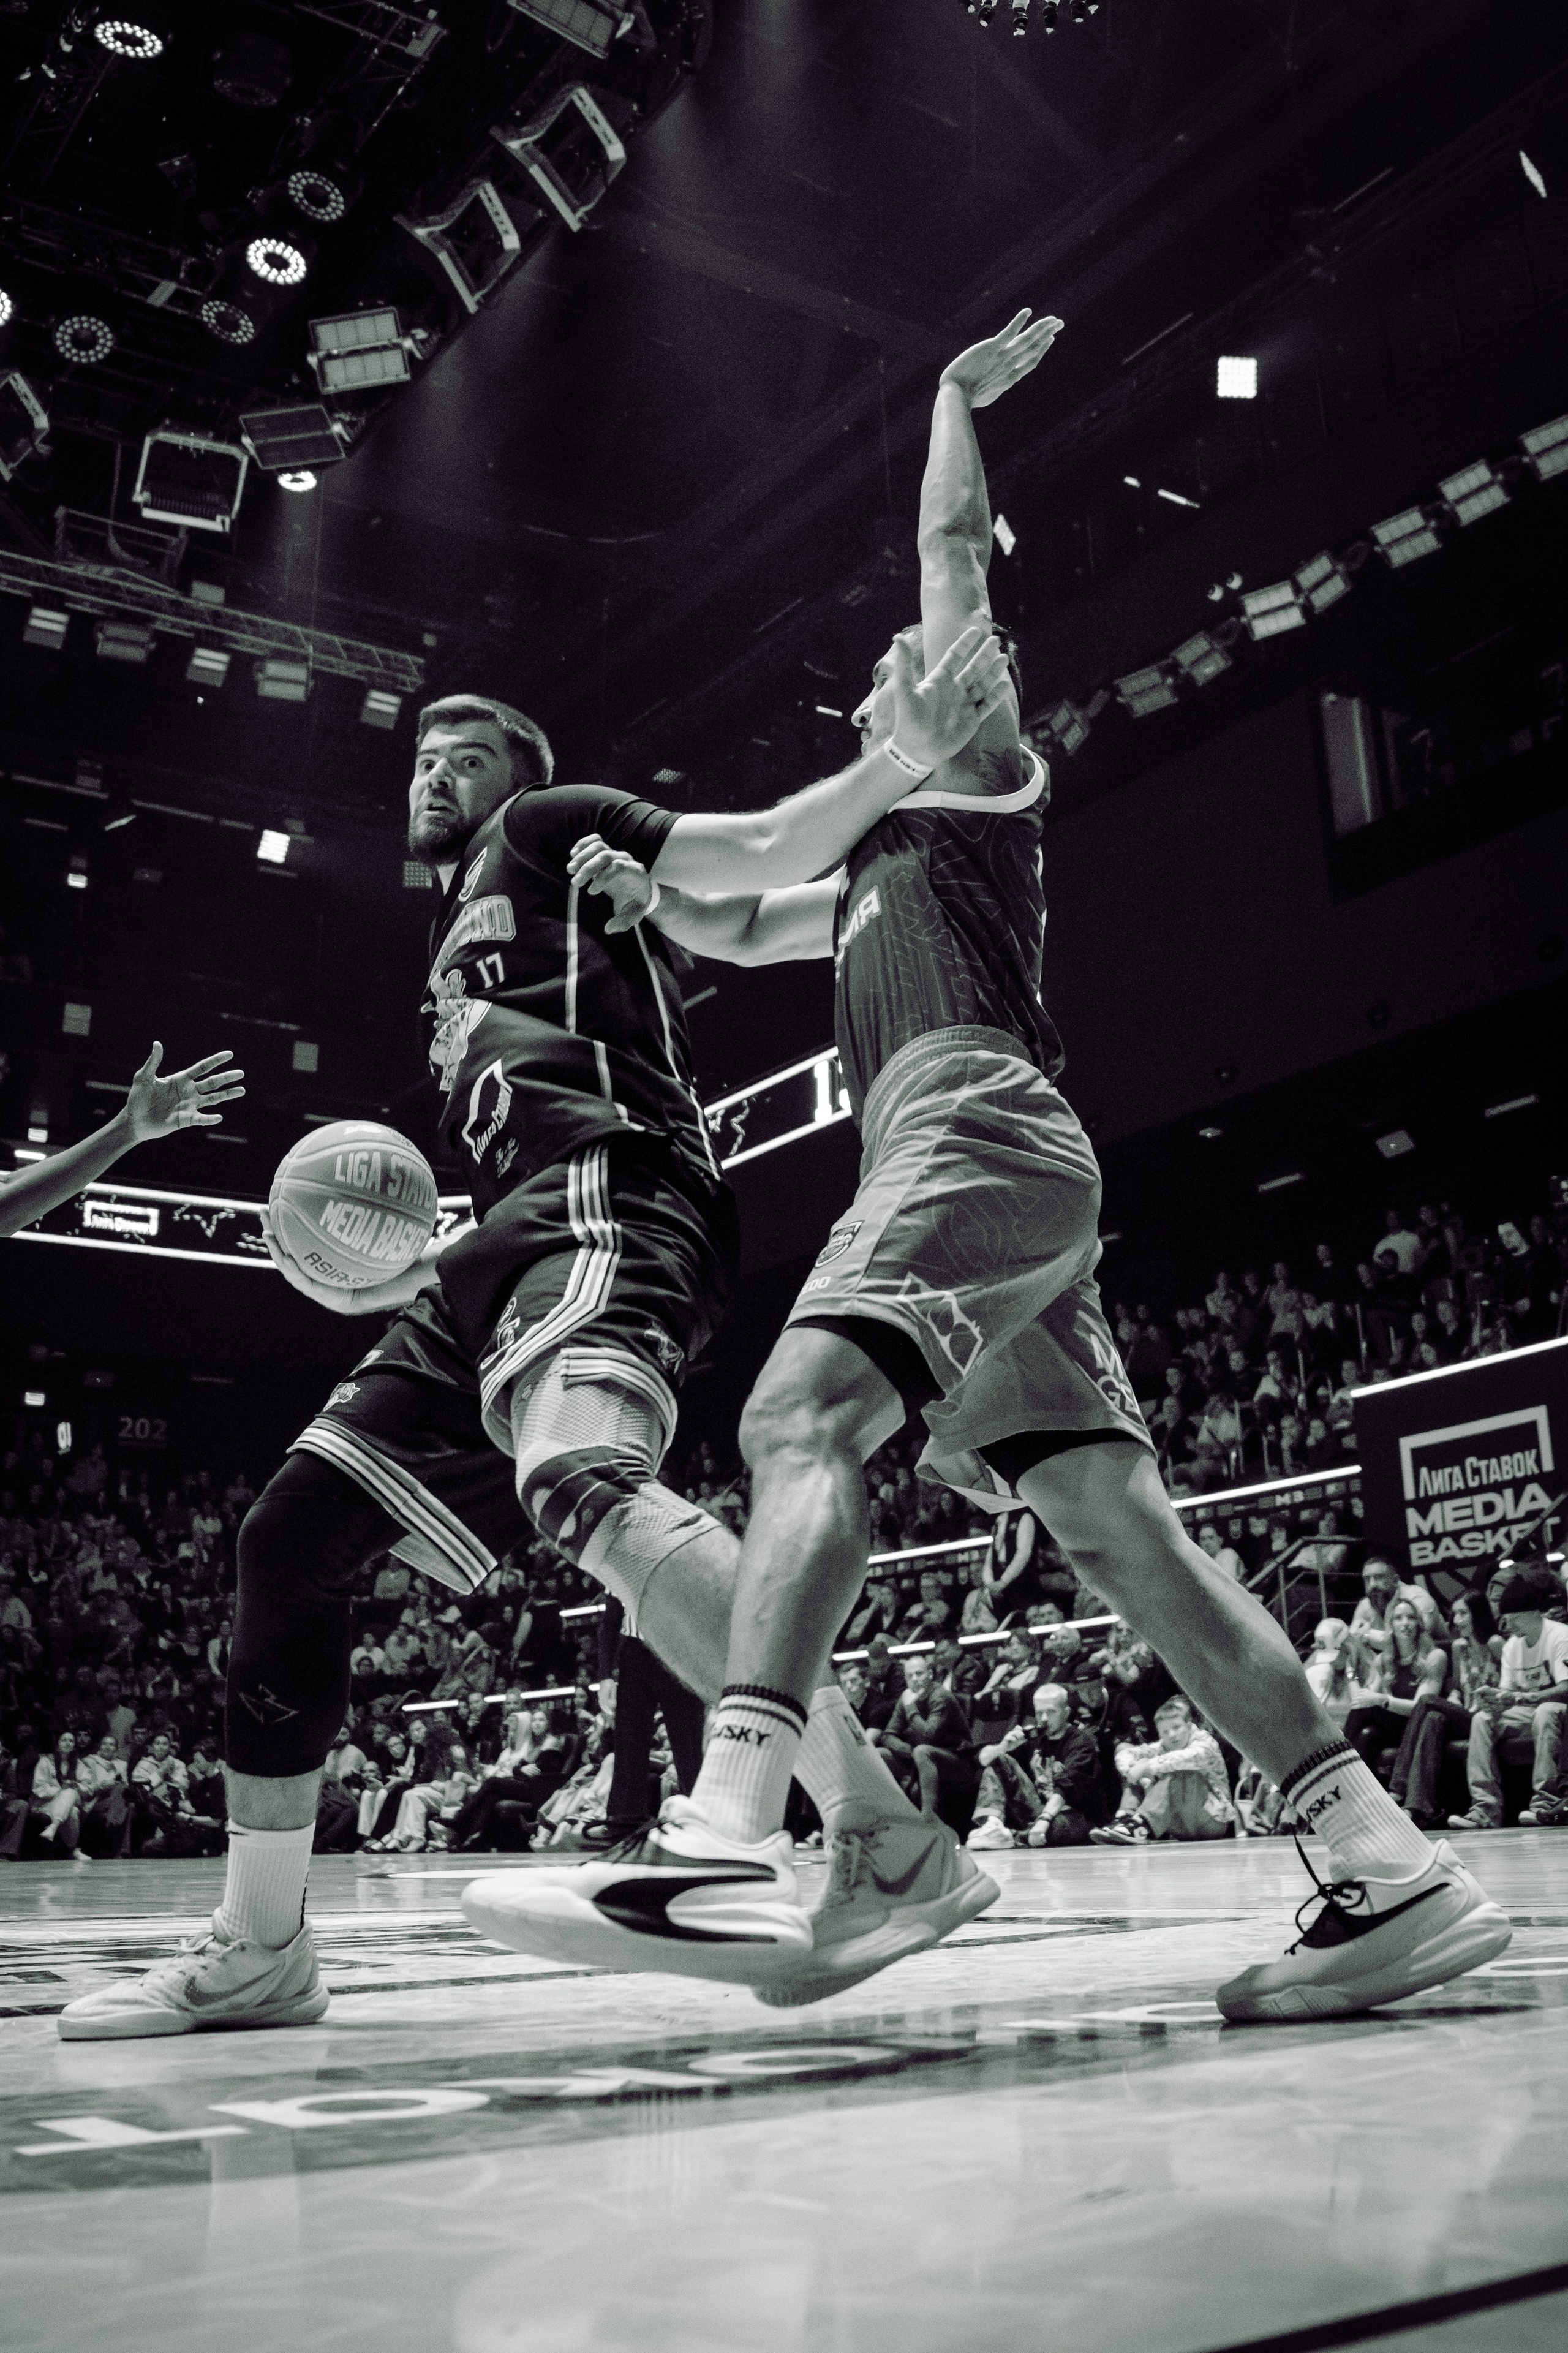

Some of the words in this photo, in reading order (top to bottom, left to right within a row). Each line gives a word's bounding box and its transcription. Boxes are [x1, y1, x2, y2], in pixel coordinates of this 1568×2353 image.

[475, 952, 505, 989] 17
[335, 1150, 381, 1192] LIGA
[320, 1199, 381, 1254] MEDIA
[119, 1416, 167, 1440] 202
[1406, 1482, 1553, 1538] MEDIA
